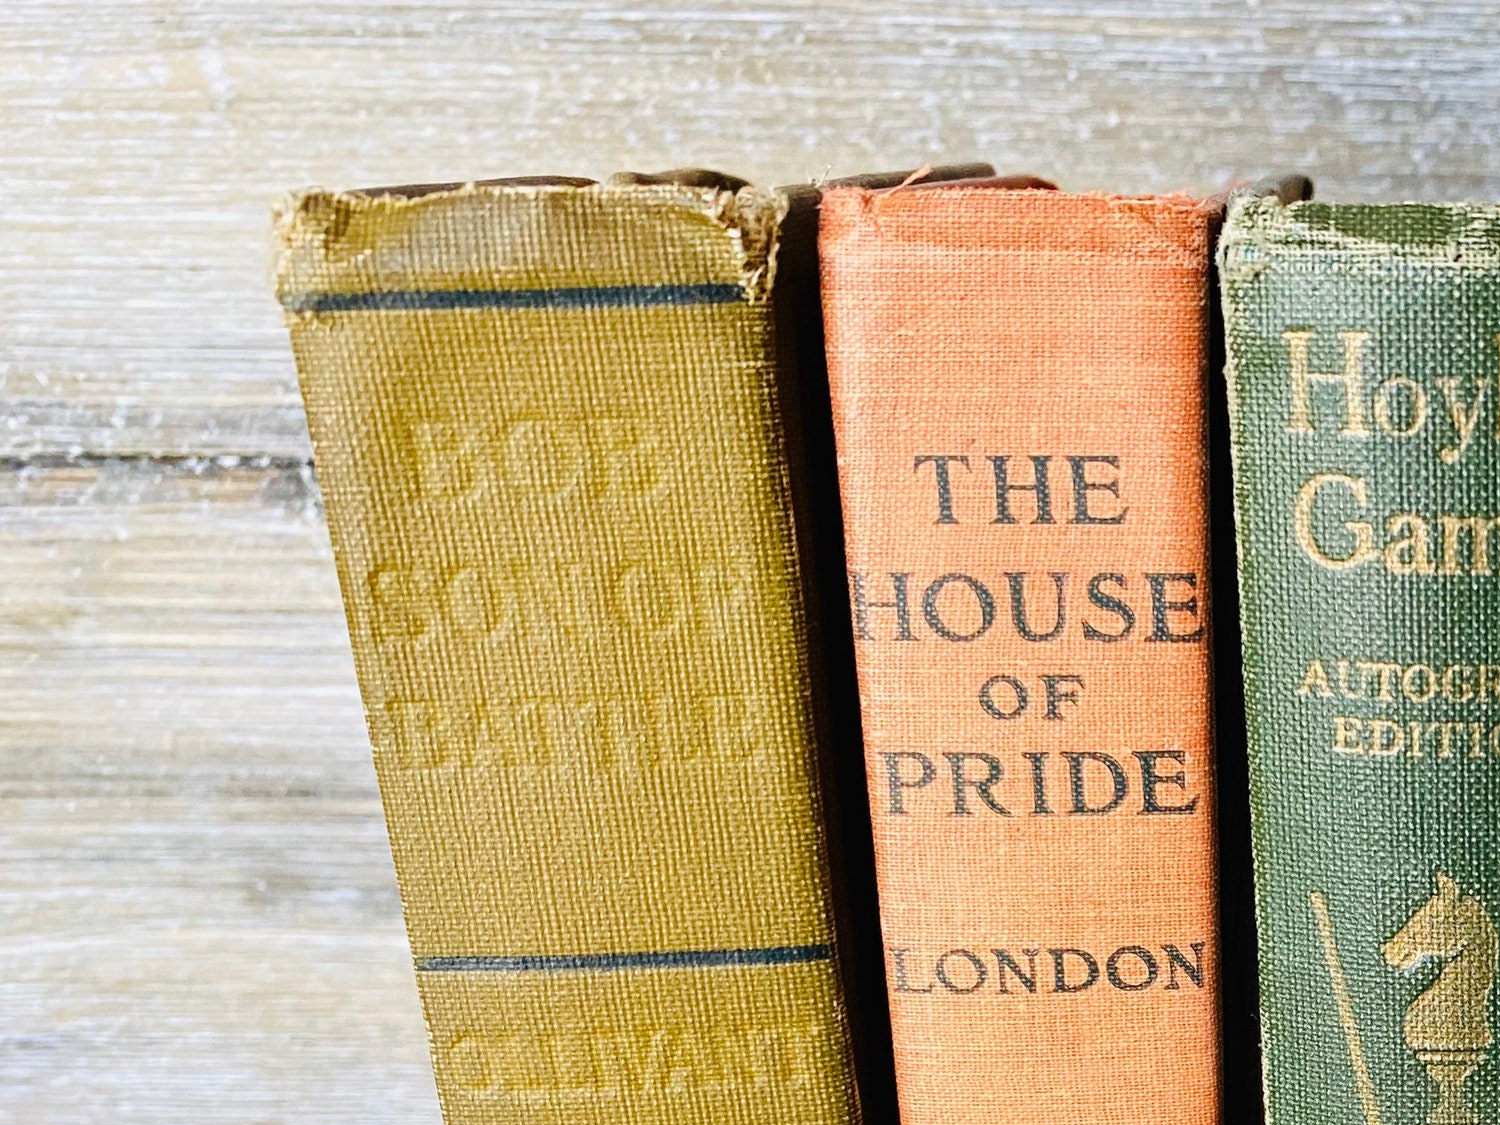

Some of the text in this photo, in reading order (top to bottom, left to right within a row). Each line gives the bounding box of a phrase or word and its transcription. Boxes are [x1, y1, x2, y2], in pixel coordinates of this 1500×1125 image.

[406, 412, 674, 503] BOB
[913, 454, 1130, 525] THE
[366, 562, 594, 650] SON
[851, 571, 1206, 643] HOUSE
[977, 674, 1087, 721] OF
[877, 750, 1202, 818] PRIDE
[888, 940, 1206, 995] LONDON
